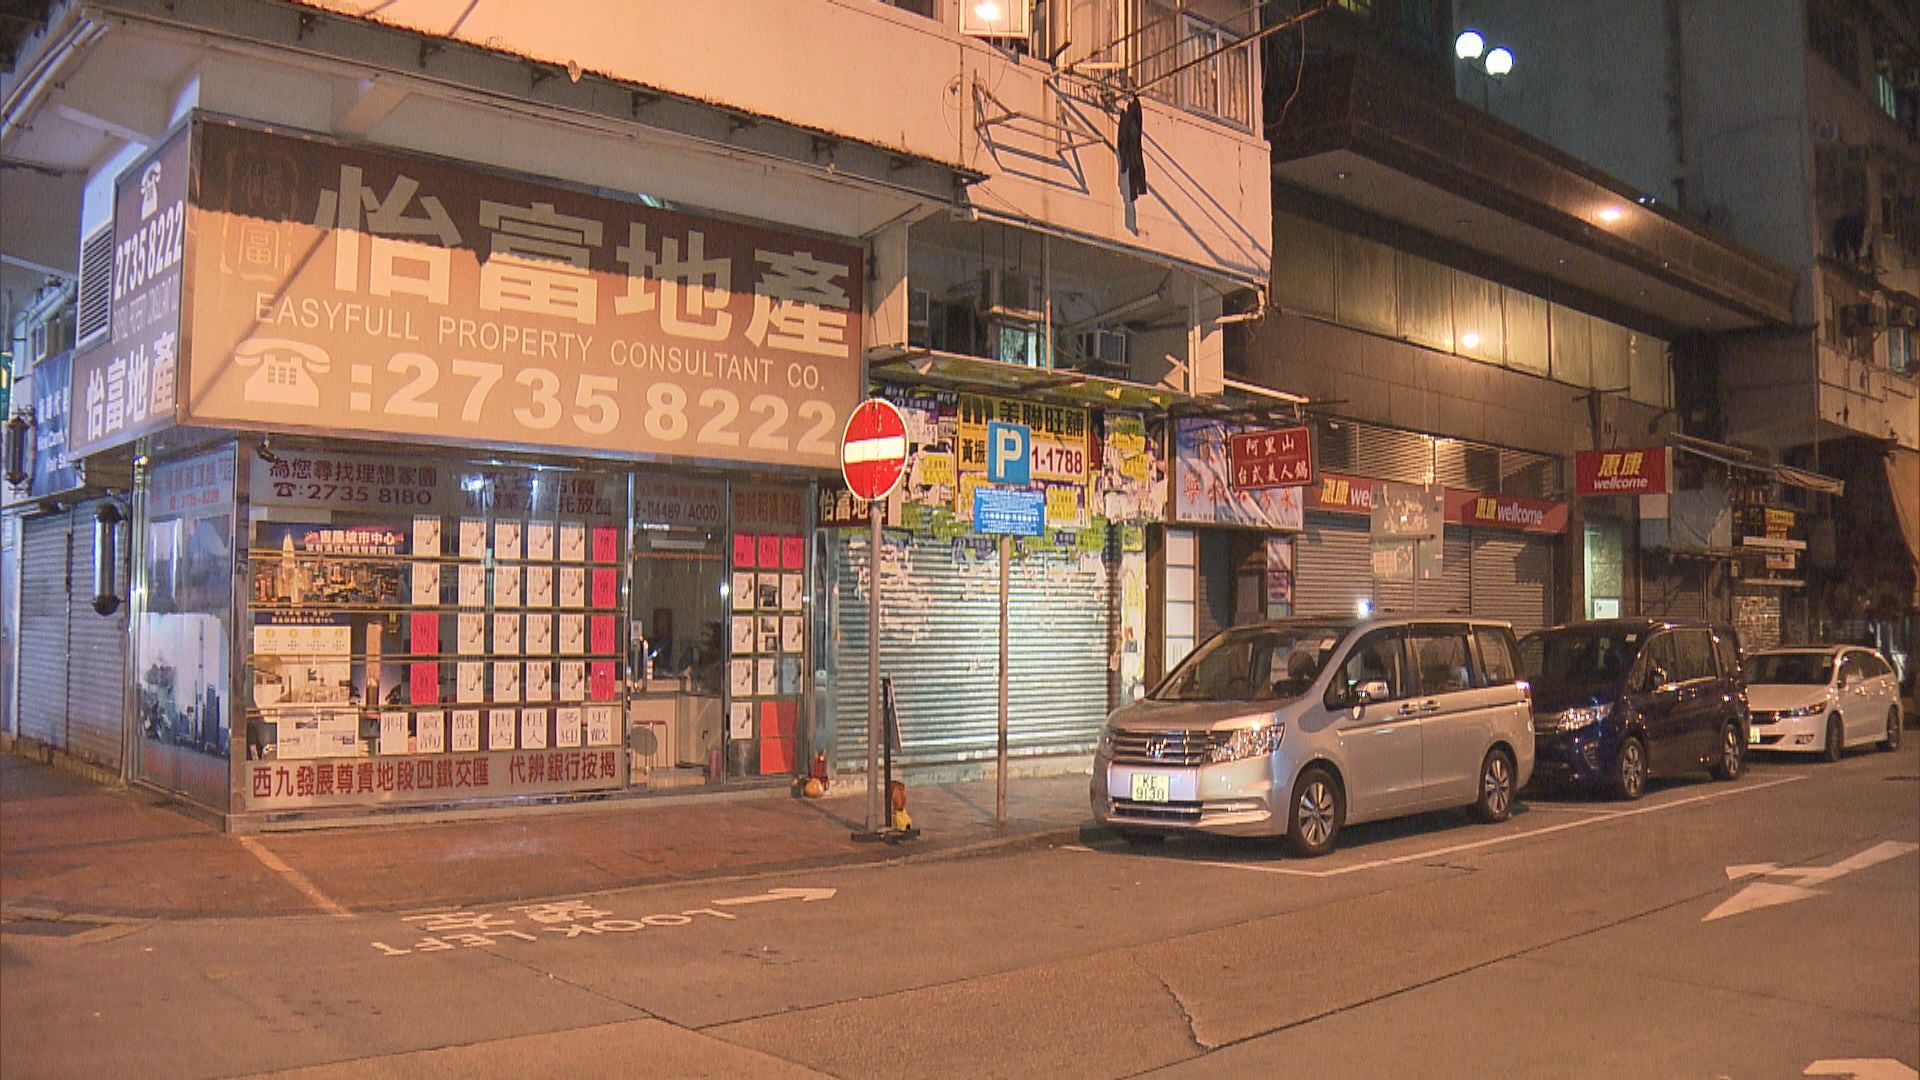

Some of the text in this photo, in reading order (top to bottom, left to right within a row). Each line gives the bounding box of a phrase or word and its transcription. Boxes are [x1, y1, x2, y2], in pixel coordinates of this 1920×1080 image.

[313, 165, 851, 357] 怡富地產
[256, 292, 826, 392] EASYFULL PROPERTY CONSULTANT CO.
[86, 331, 176, 442] 怡富地產
[996, 428, 1023, 479] P
[1245, 434, 1295, 456] 阿里山
[269, 457, 437, 488] 為您尋找理想家園
[1598, 452, 1644, 477] 惠康
[1593, 476, 1649, 490] wellcome
[819, 488, 886, 521] 怡富地
[1497, 502, 1544, 526] wellcome
[252, 757, 489, 799] 西九發展尊貴地段四鐵交匯
[370, 929, 538, 956] LEFT
